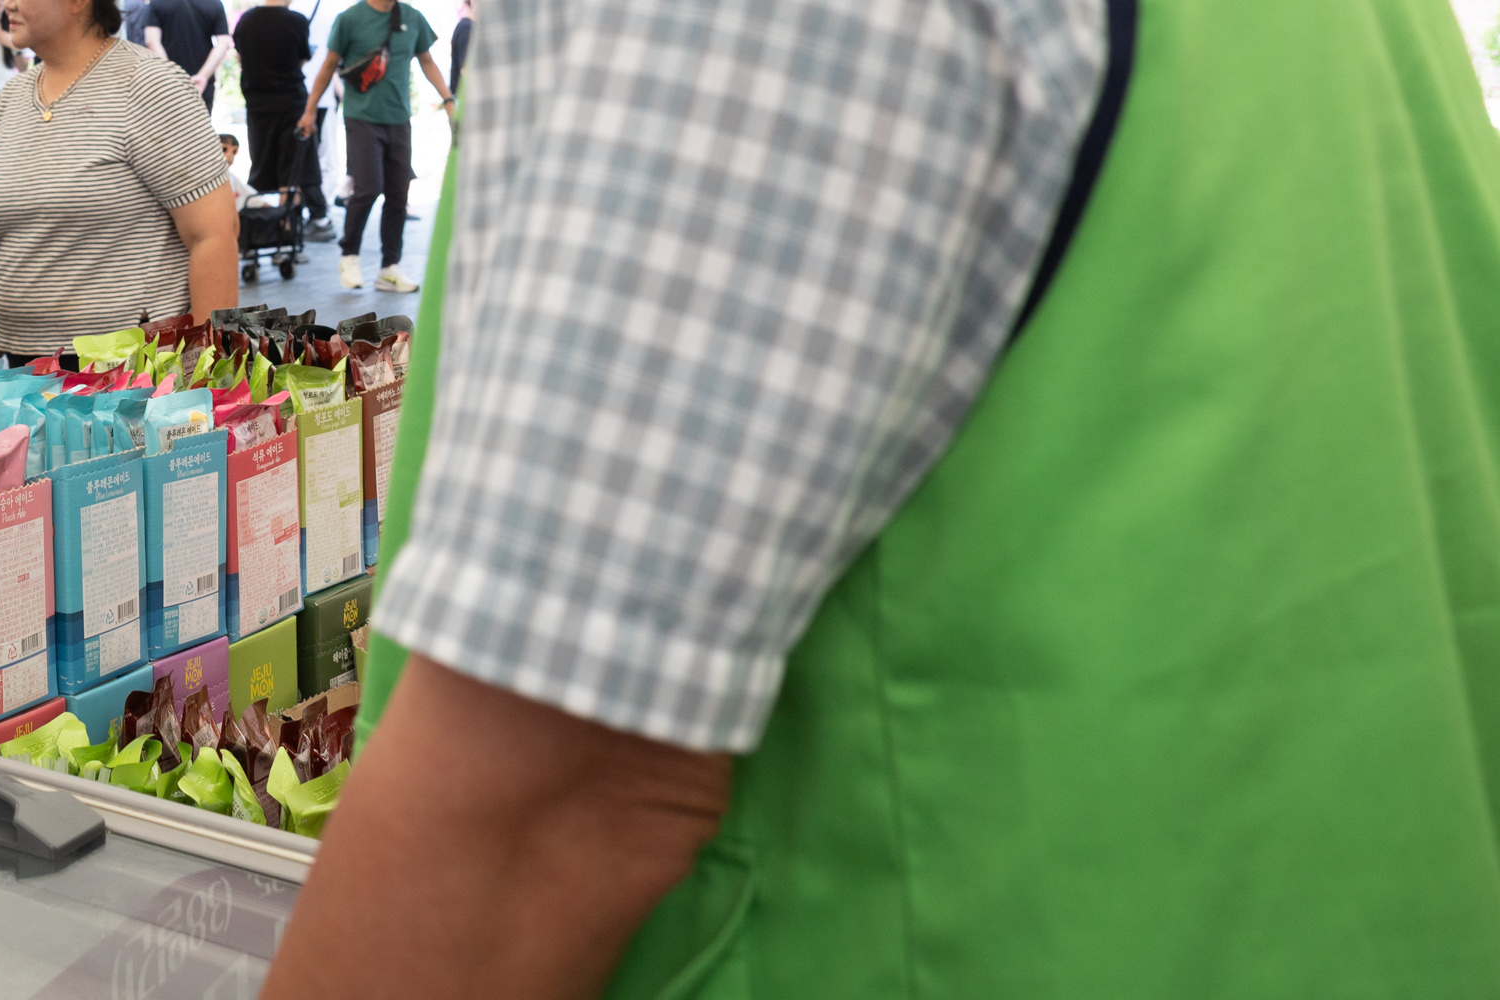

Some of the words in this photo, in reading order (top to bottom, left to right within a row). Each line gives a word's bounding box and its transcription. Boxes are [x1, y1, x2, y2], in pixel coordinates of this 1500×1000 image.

[314, 410, 333, 426] 청포도
[334, 405, 351, 420] 에이드
[252, 448, 265, 463] 석류
[266, 442, 284, 458] 에이드
[14, 490, 35, 507] 에이드
[343, 598, 358, 613] JEJU
[343, 608, 358, 625] MON
[185, 656, 201, 672] JEJU
[251, 662, 272, 683] JEJU
[185, 666, 203, 686] MON
[250, 675, 274, 701] MON
[14, 721, 33, 739] JEJU
